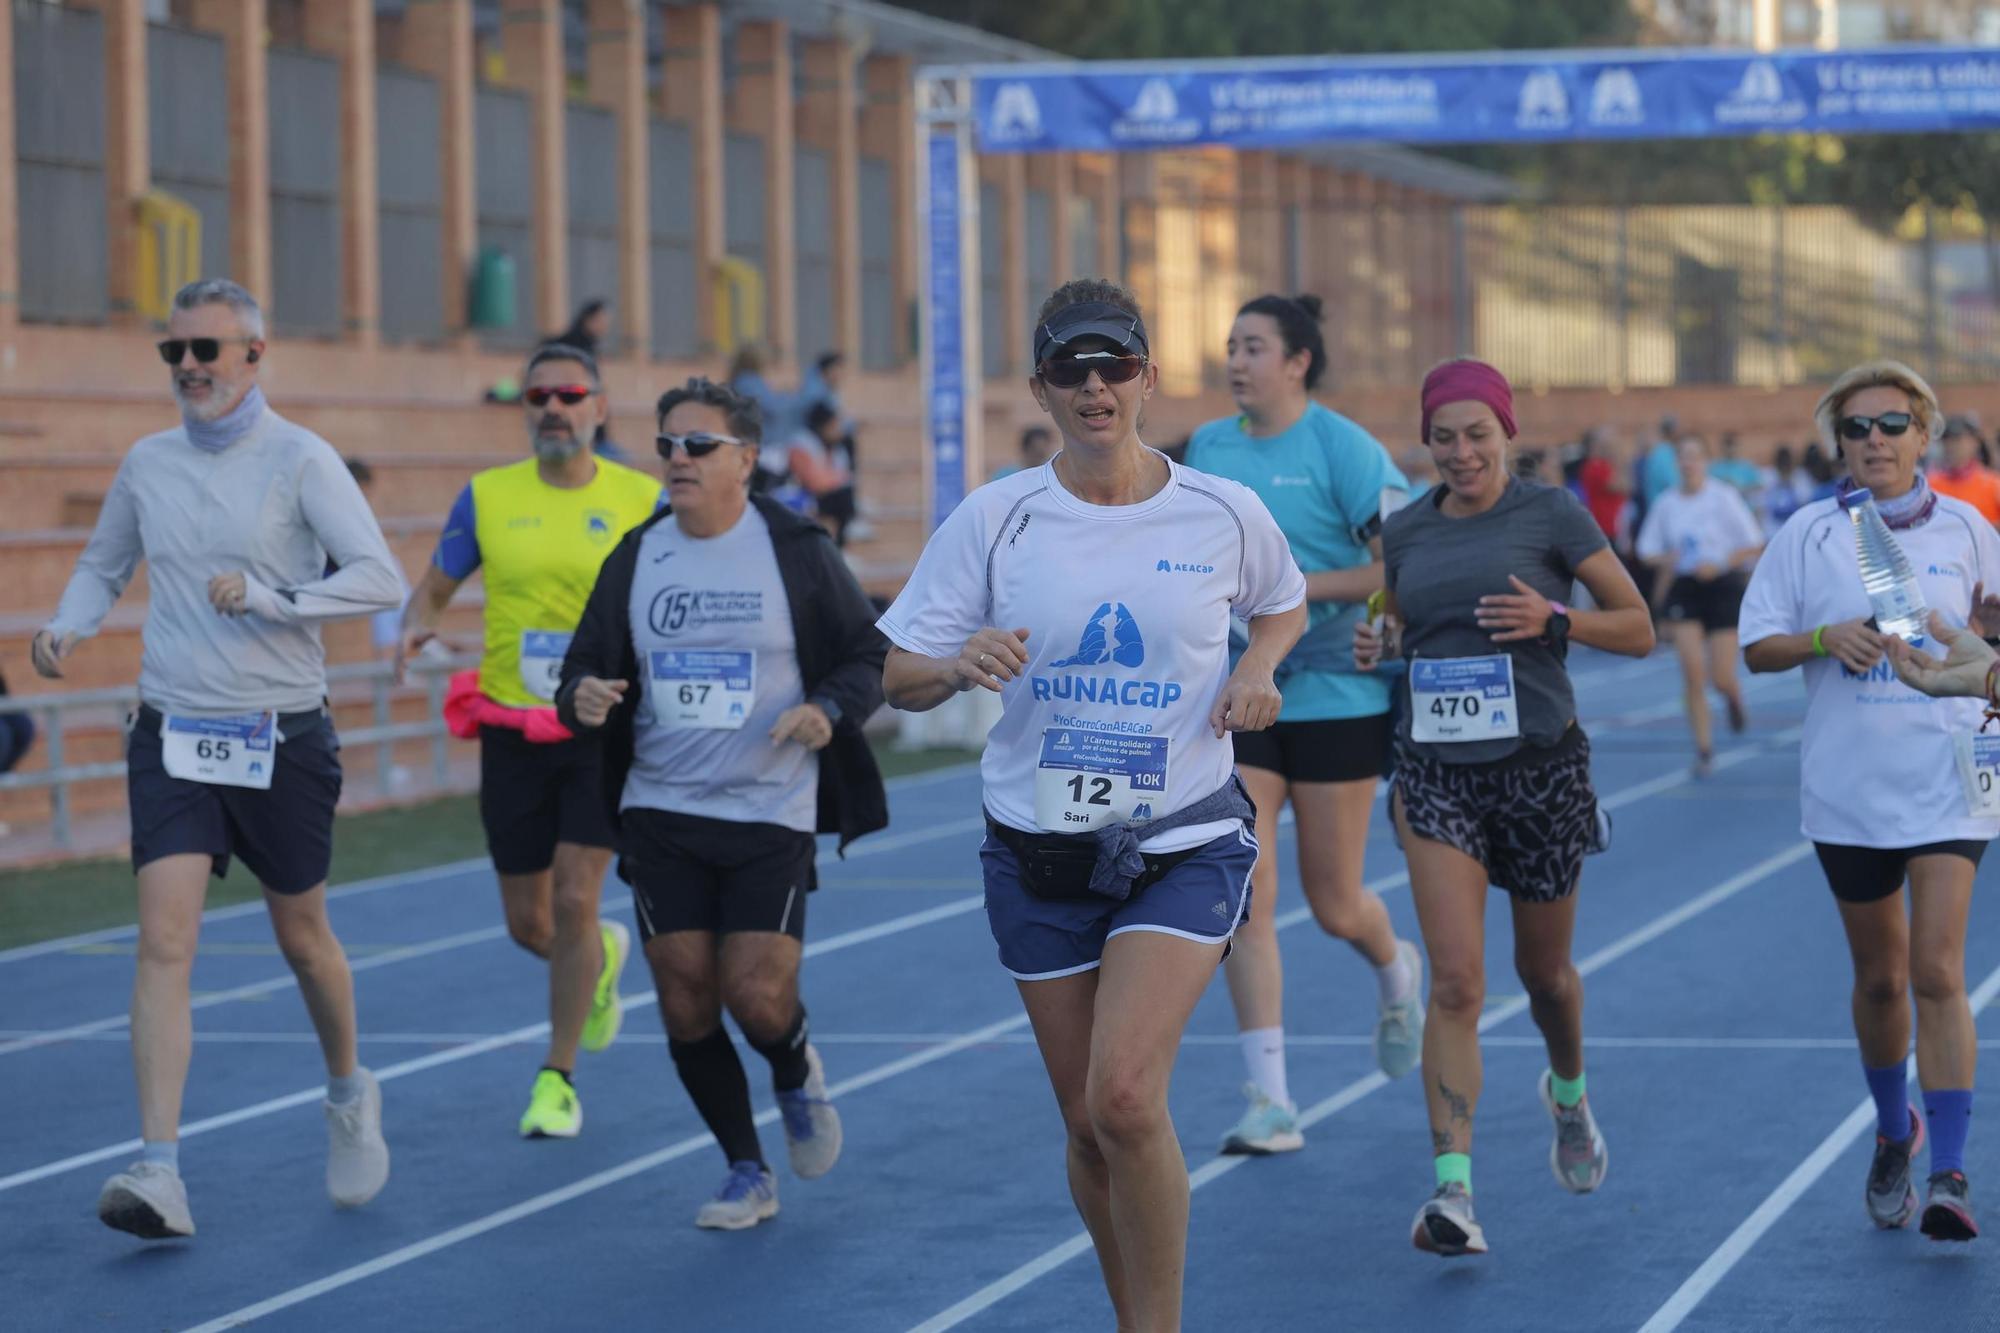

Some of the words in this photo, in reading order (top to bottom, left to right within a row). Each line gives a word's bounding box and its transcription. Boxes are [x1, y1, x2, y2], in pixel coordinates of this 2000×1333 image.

[679, 684, 712, 705] 67
[1485, 684, 1508, 697] 10K
[1430, 695, 1480, 718] 470
[196, 738, 231, 761] 65
[1090, 736, 1117, 747] Carrera
[1119, 739, 1152, 750] solidaria
[1082, 744, 1092, 752] por
[1128, 748, 1151, 757] pulmón
[1135, 773, 1161, 786] 10K
[1067, 774, 1113, 806] 12
[1063, 811, 1090, 823] Sari
